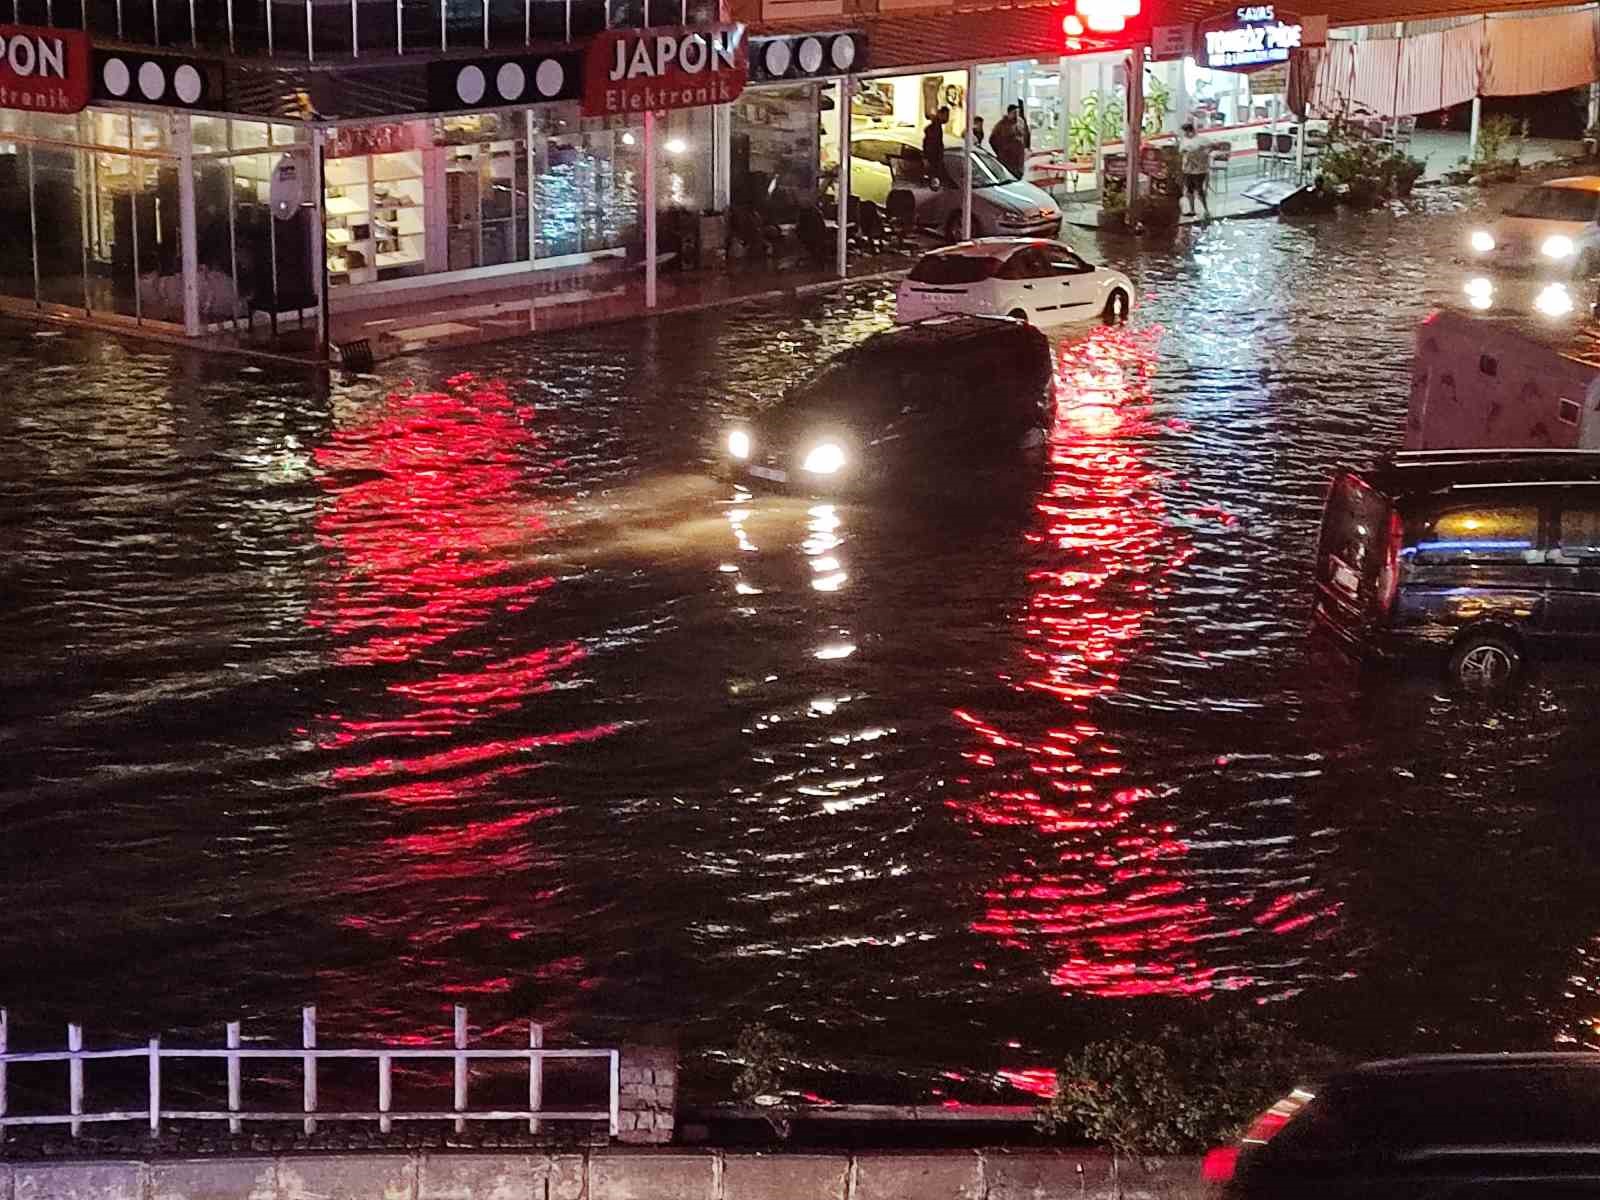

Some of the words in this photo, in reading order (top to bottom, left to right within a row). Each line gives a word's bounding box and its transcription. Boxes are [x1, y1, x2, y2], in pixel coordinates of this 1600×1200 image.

[0, 33, 65, 80] ON
[609, 24, 745, 81] JAPON
[605, 81, 730, 112] Elektronik
